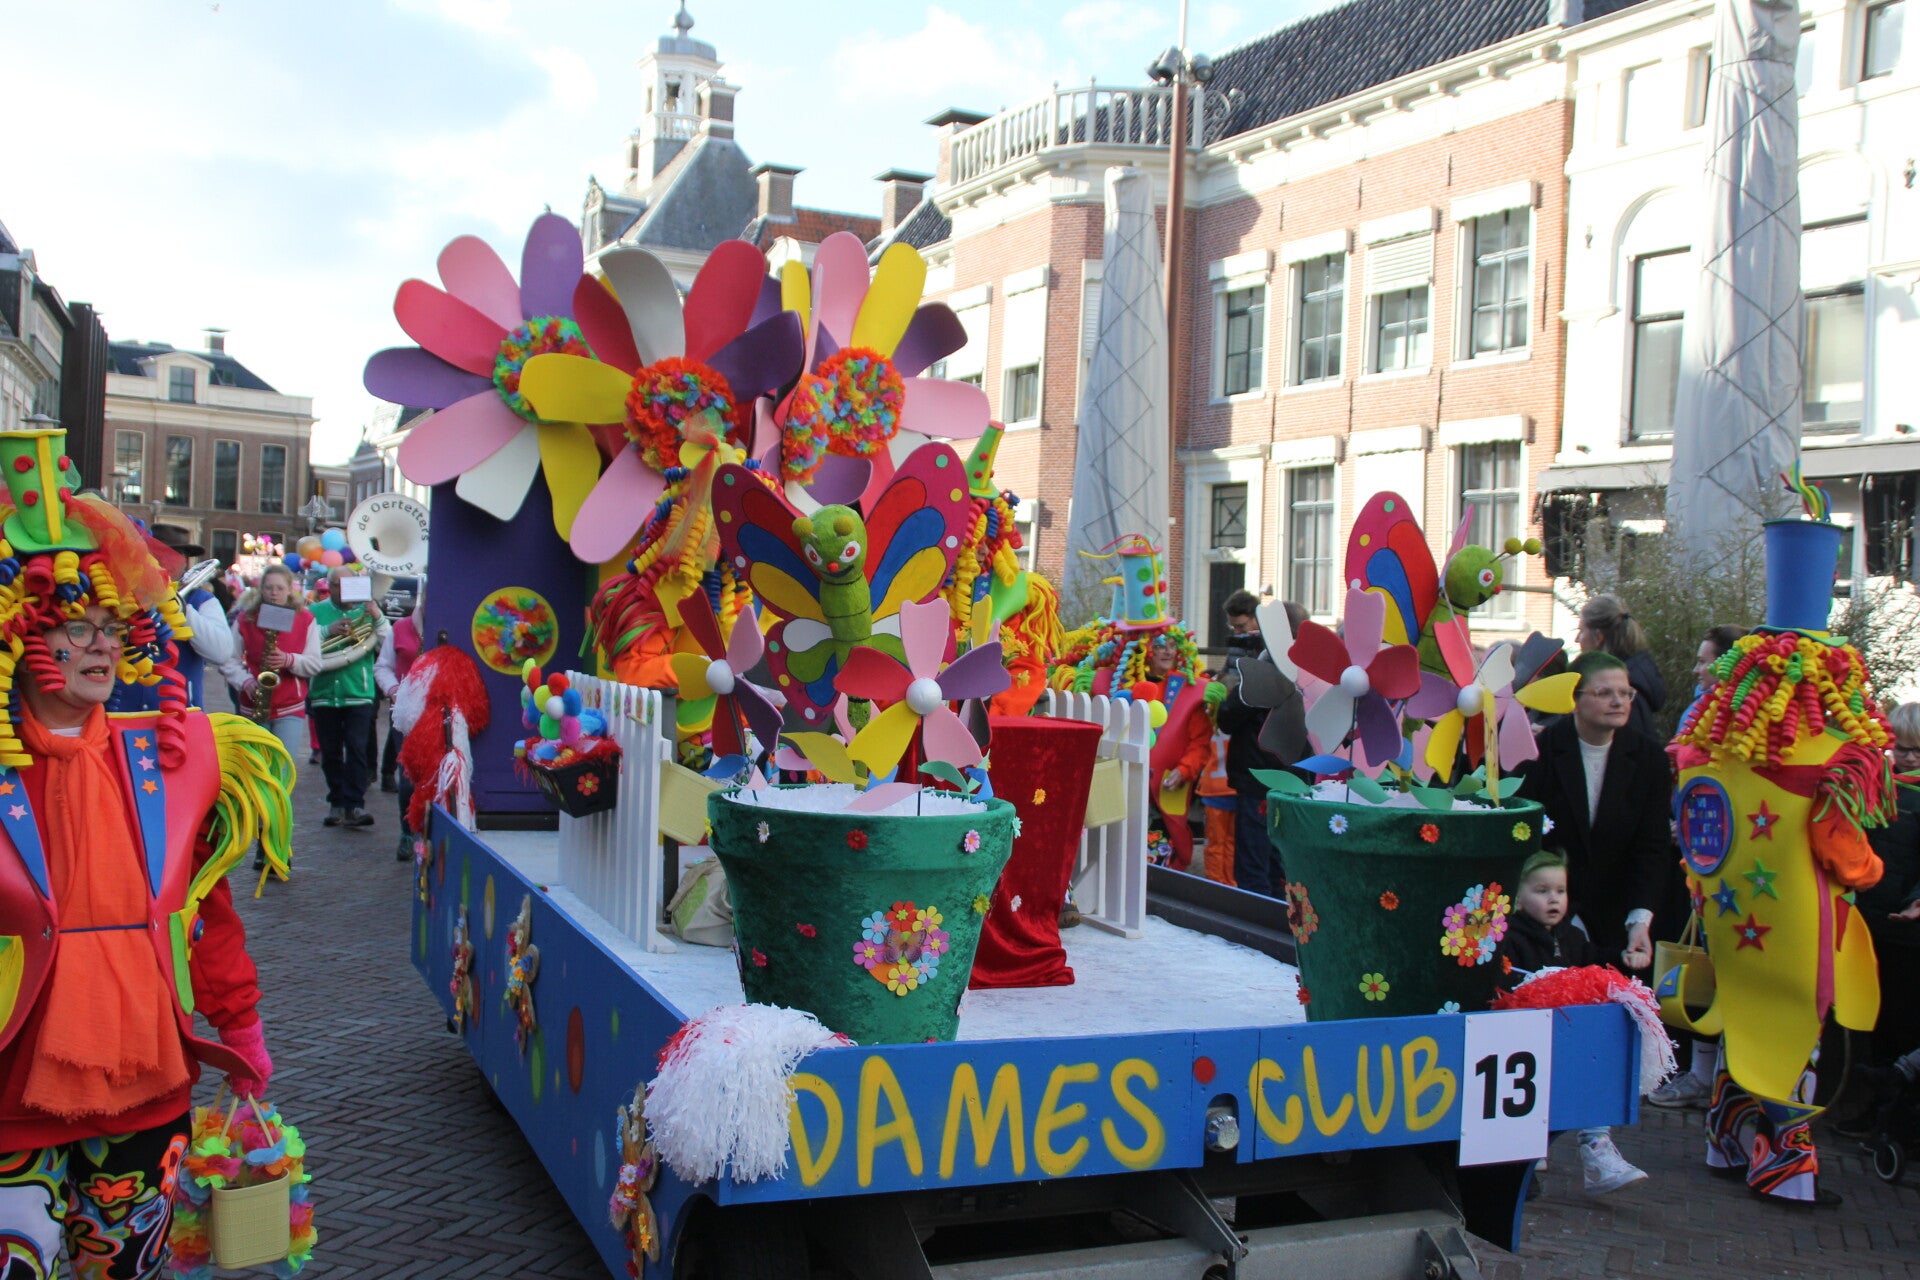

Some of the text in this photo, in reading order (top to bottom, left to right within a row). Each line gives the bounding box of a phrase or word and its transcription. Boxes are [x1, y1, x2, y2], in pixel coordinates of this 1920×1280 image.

[357, 514, 370, 531] de
[362, 553, 414, 572] Ureterp
[1475, 1051, 1537, 1120] 13
[788, 1035, 1457, 1188] DAMES CLUB
